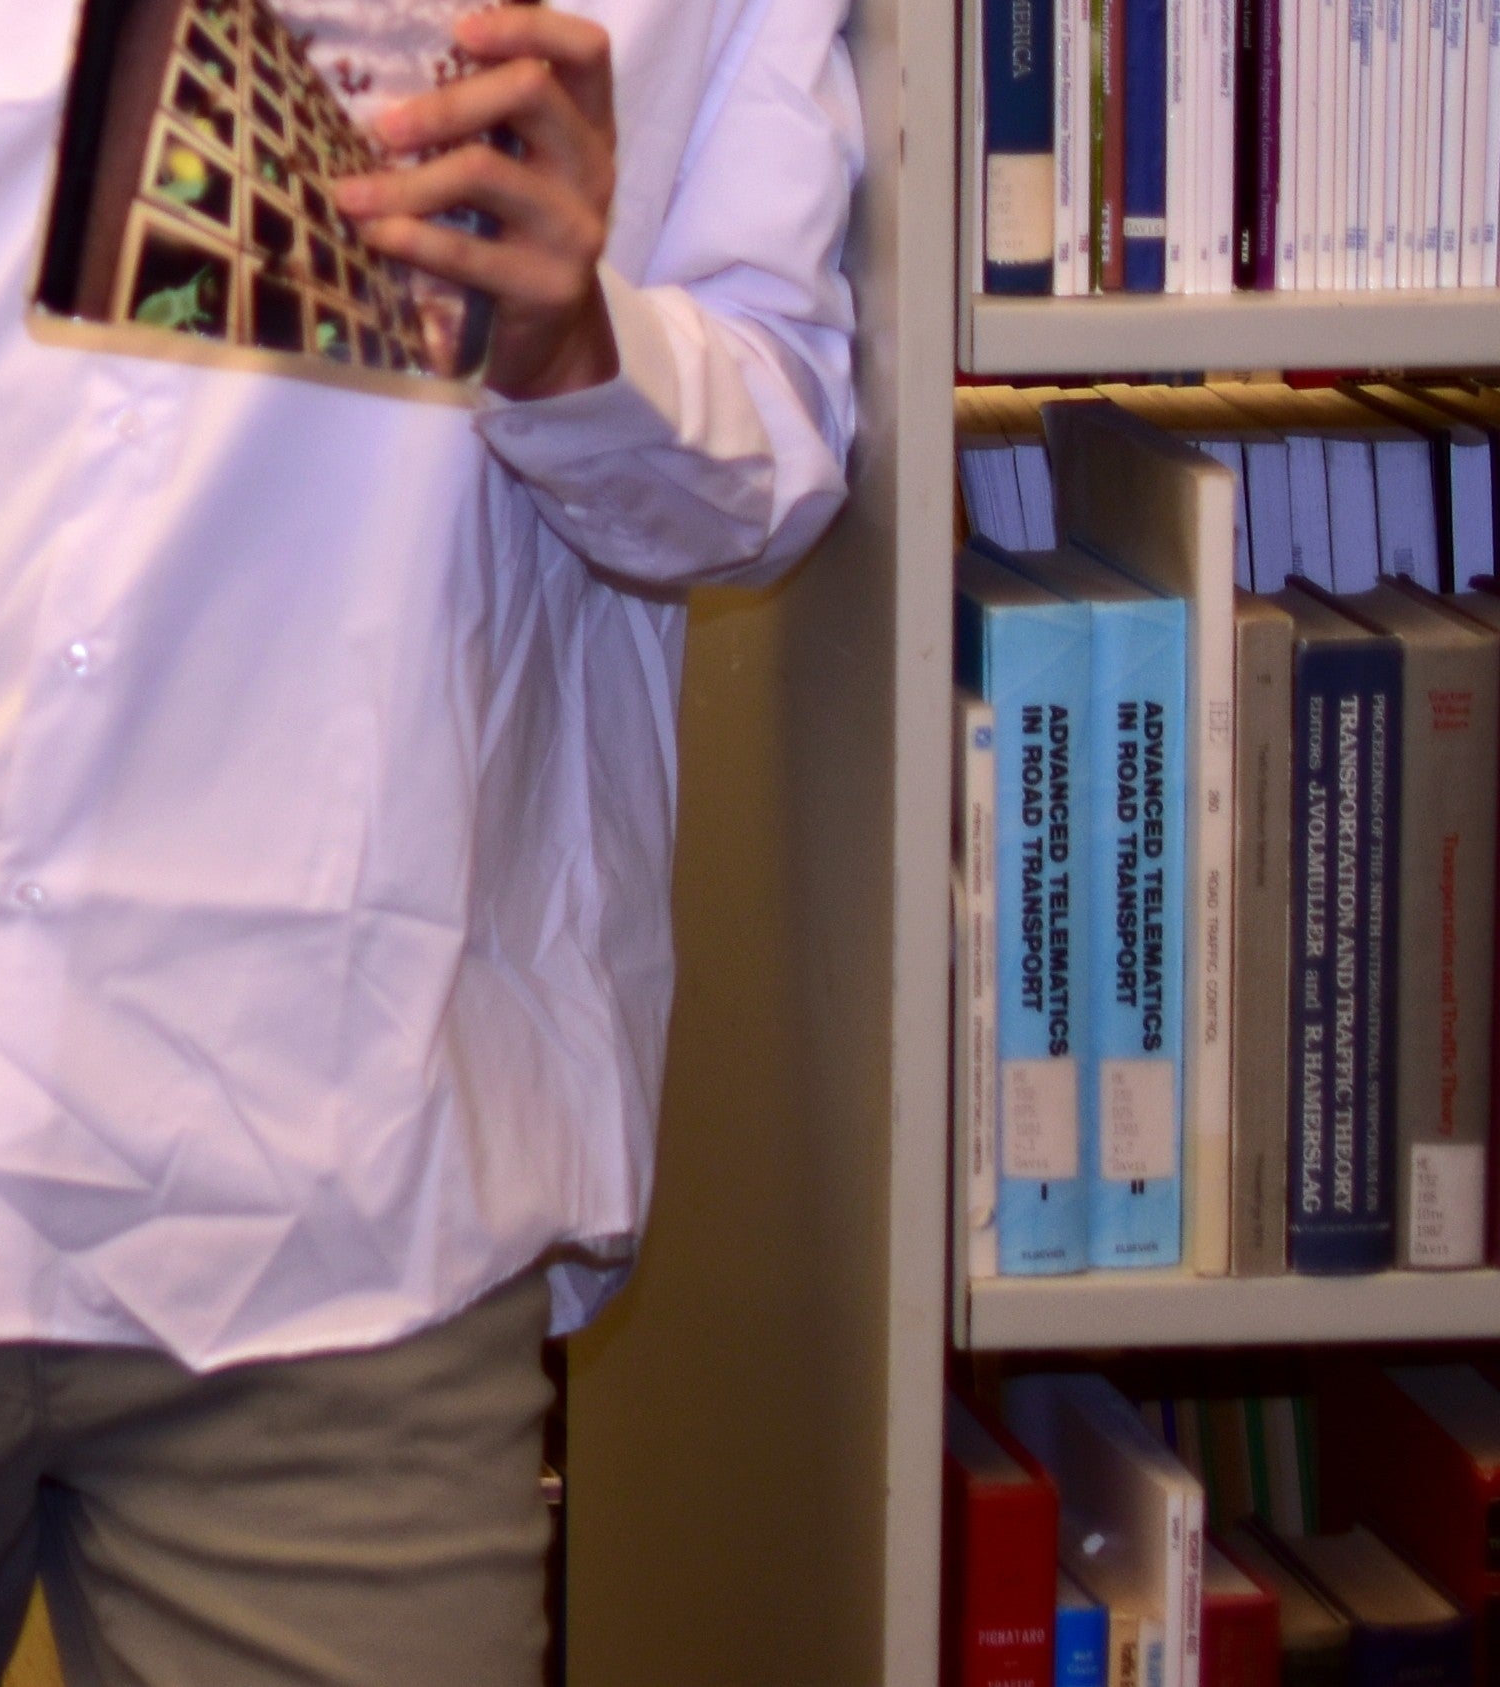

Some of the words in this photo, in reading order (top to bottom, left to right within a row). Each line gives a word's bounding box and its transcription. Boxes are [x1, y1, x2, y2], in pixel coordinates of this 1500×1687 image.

[1022, 704, 1042, 733] IN
[1117, 701, 1137, 730] IN
[1370, 694, 1384, 814] PROCEEDINGS
[1022, 744, 1042, 828] ROAD
[1049, 704, 1069, 863] ADVANCED
[1117, 740, 1137, 823] ROAD
[1143, 700, 1163, 858] ADVANCED
[1336, 695, 1359, 928] TRANSPORTATION
[1370, 817, 1384, 839] OF
[1369, 881, 1383, 937] NINTH
[1370, 845, 1384, 878] THE
[1441, 832, 1458, 965] Transportation
[1022, 837, 1042, 1013] TRANSPORT
[1049, 872, 1069, 1057] TELEMATICS
[1117, 832, 1137, 1007] TRANSPORT
[1143, 867, 1163, 1051] TELEMATICS
[1335, 933, 1358, 989] AND
[1367, 940, 1382, 1077] INTERNATIONAL
[1441, 971, 1458, 1004] and
[1441, 1007, 1458, 1066] Traffic
[1334, 994, 1356, 1103] TRAFFIC
[1366, 1080, 1380, 1182] SYMPOSIUM
[1439, 1072, 1457, 1136] Theory
[1333, 1106, 1354, 1213] THEORY
